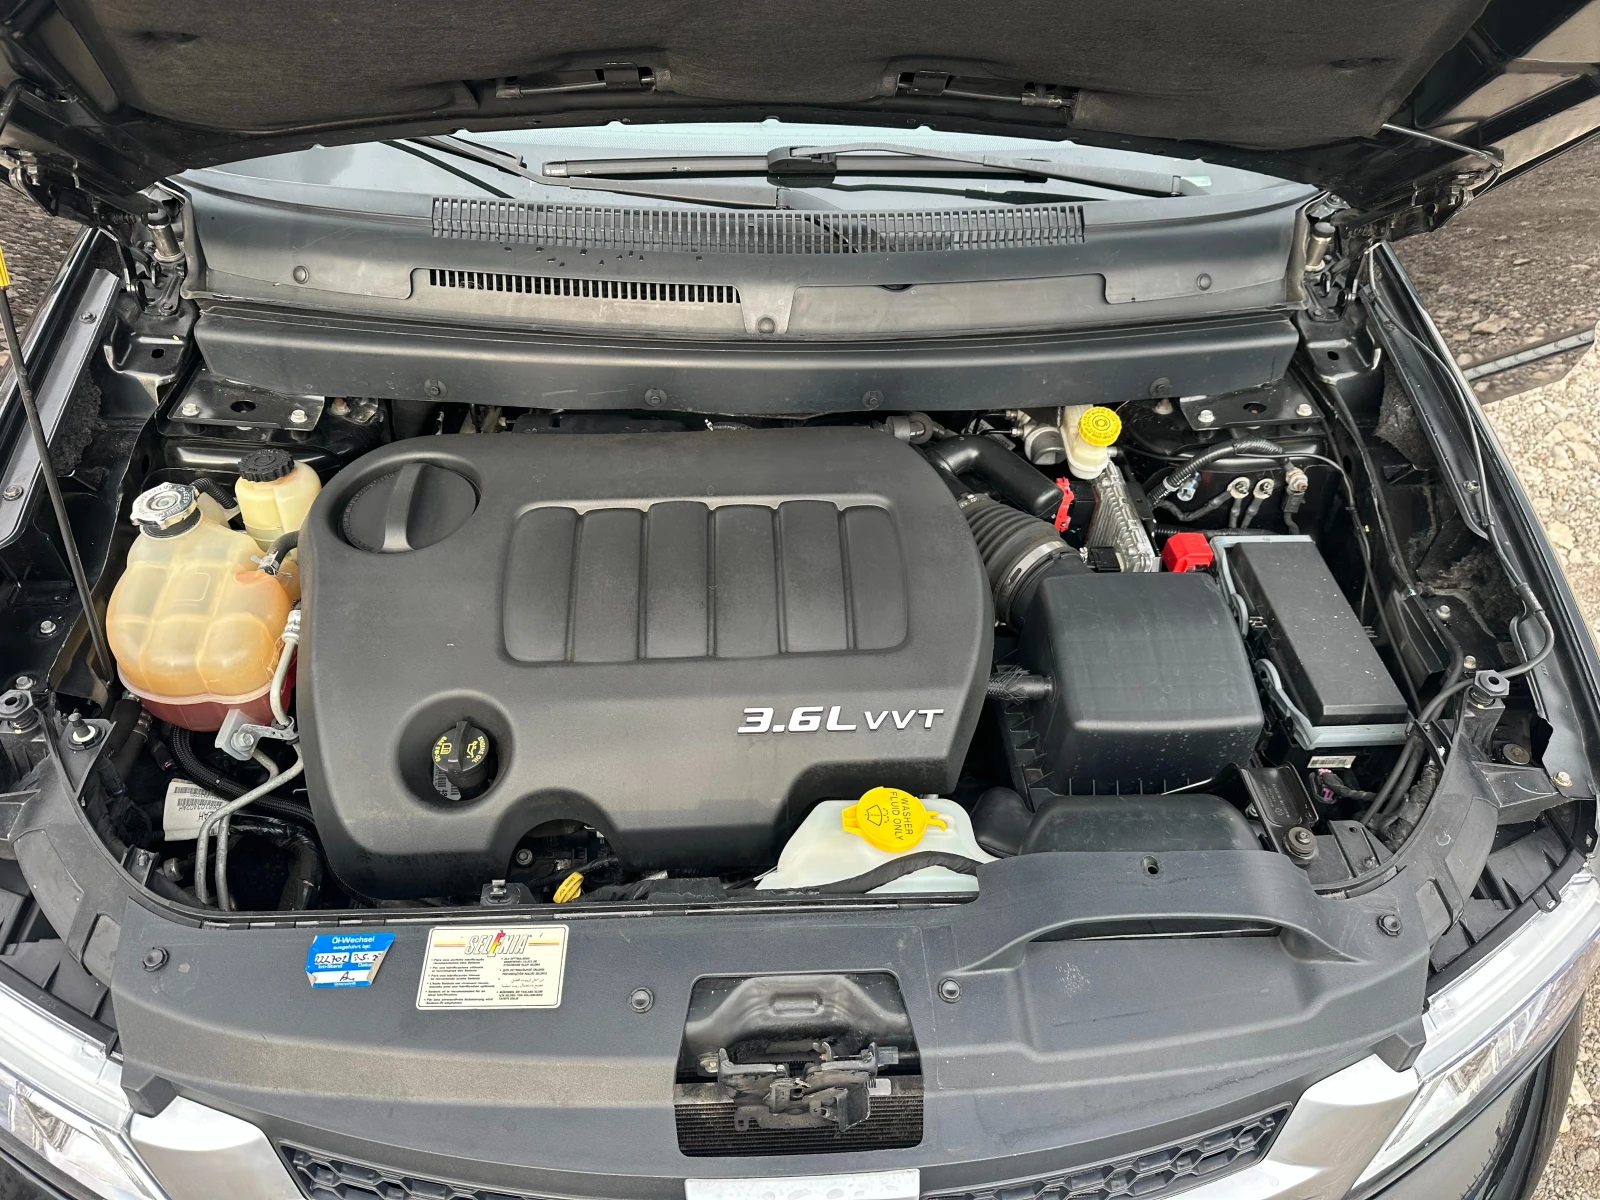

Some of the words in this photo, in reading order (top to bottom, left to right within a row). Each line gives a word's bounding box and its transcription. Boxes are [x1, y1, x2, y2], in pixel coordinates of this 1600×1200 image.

[737, 706, 857, 734] 3.6L
[864, 708, 944, 731] VVT
[890, 791, 900, 816] FLUID
[900, 797, 913, 835] WASHER
[893, 818, 904, 841] ONLY
[331, 935, 376, 945] Öl-Wechsel
